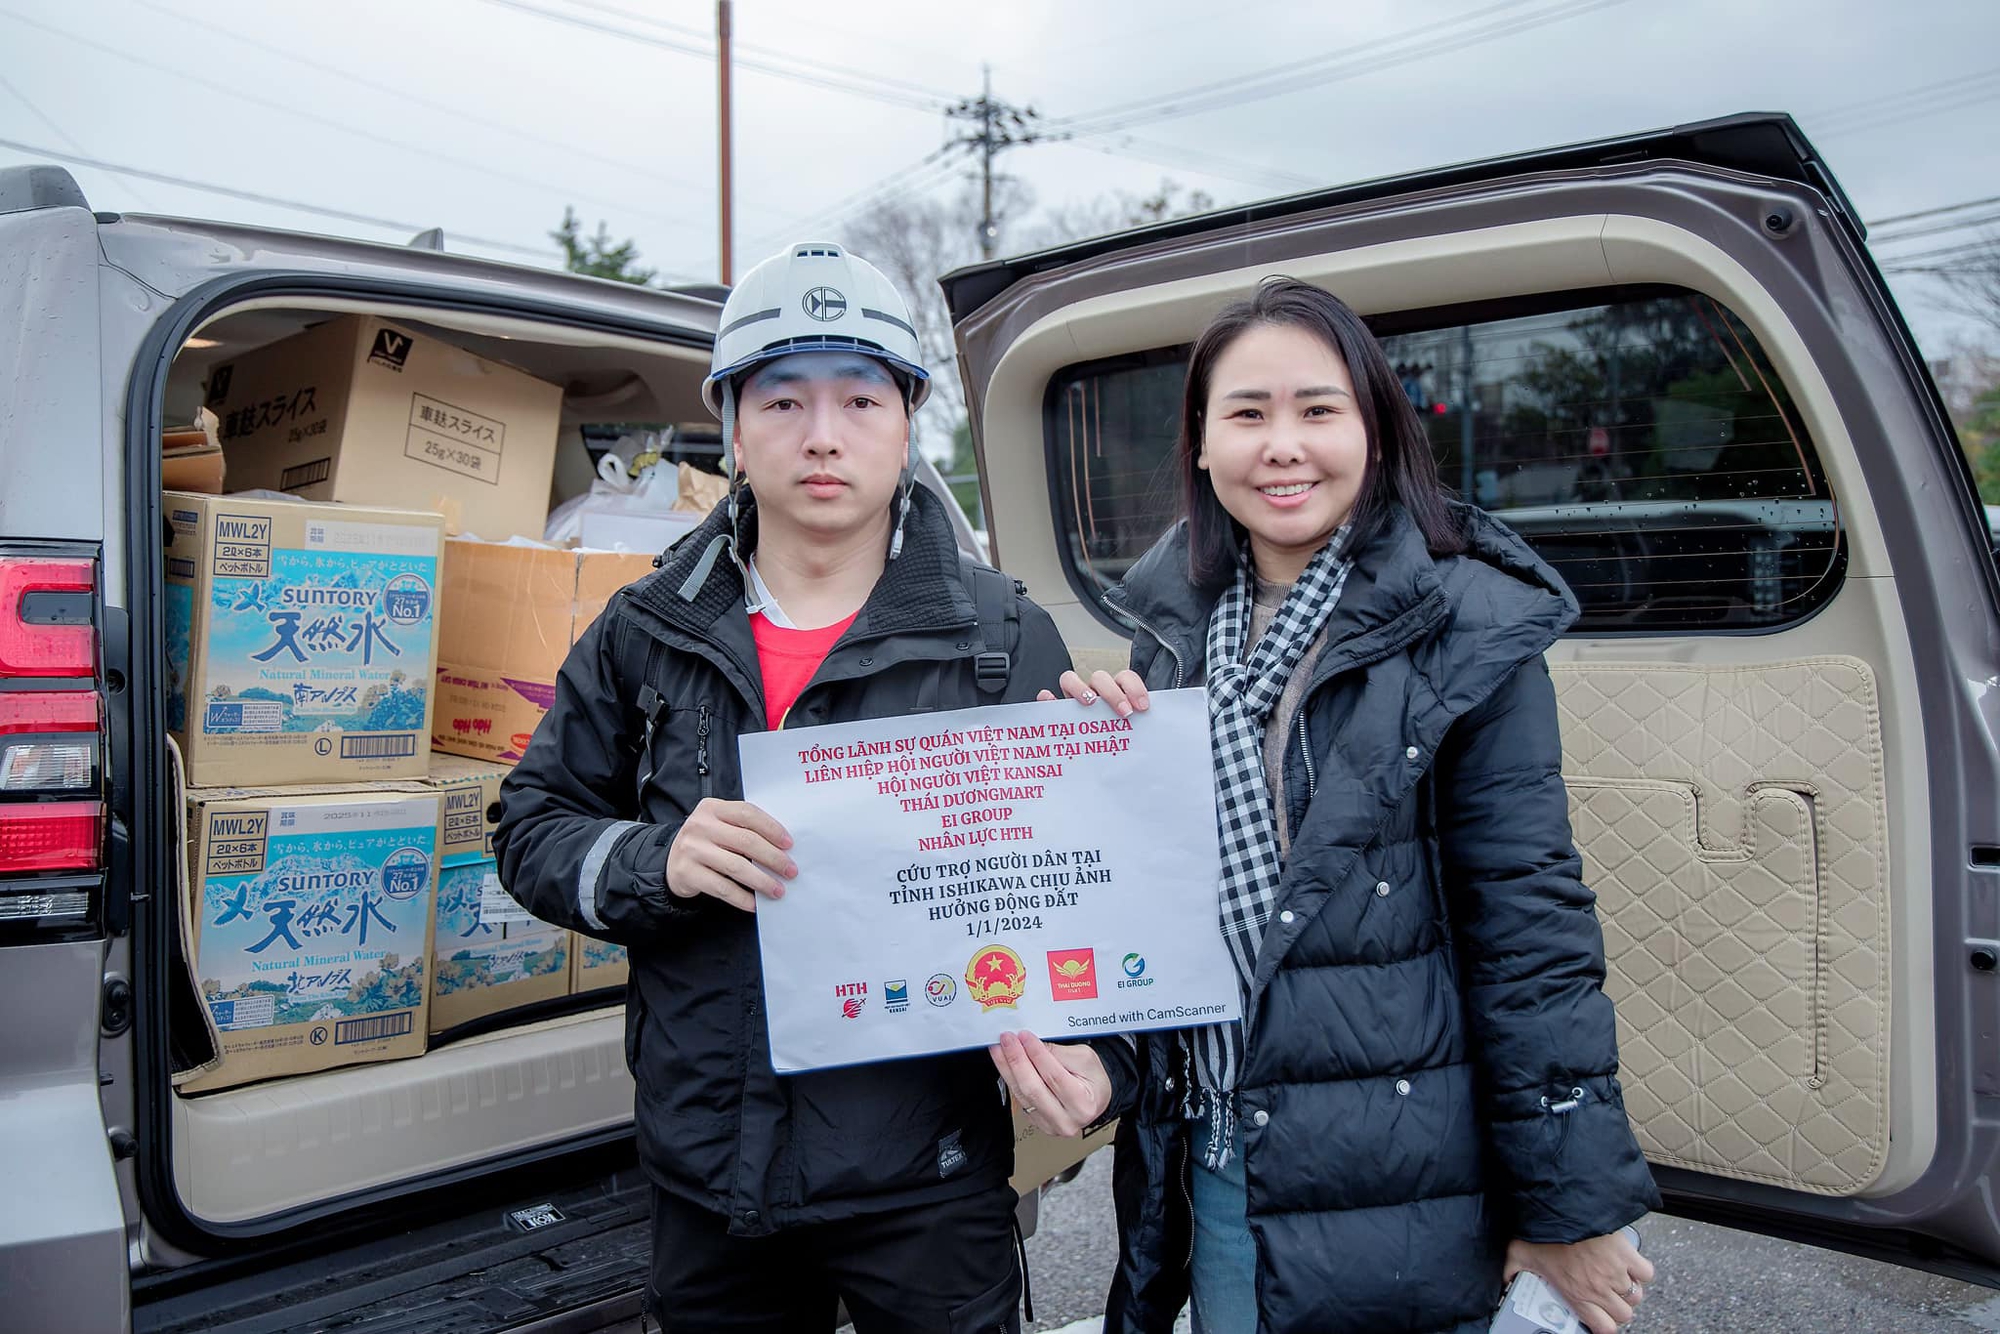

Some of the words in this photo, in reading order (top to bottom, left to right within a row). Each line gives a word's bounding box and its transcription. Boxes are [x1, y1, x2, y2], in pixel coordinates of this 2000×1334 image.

[219, 521, 268, 540] MWL2Y
[219, 562, 263, 574] ペットボトル
[283, 588, 378, 607] SUNTORY
[392, 604, 421, 618] No.1
[251, 610, 401, 666] 天然水
[259, 669, 306, 680] Natural
[309, 669, 356, 680] Mineral
[359, 669, 391, 680] Water
[798, 743, 844, 765] TỔNG
[847, 740, 894, 758] LÃNH
[895, 737, 917, 754] SỰ
[919, 729, 964, 752] QUÁN
[966, 726, 1004, 745] VIỆT
[1006, 725, 1046, 740] NAM
[1048, 723, 1075, 740] TẠI
[1078, 718, 1133, 735] OSAKA
[804, 763, 842, 784] LIÊN
[845, 760, 884, 780] HIỆP
[886, 758, 917, 776] HỘI
[919, 748, 972, 770] NGƯỜI
[972, 745, 1010, 765] VIỆT
[1012, 744, 1051, 760] NAM
[1053, 742, 1081, 759] TẠI
[1084, 735, 1130, 754] NHẬT
[877, 777, 907, 797] HỘI
[909, 769, 962, 791] NGƯỜI
[963, 764, 1001, 785] VIỆT
[1003, 764, 1063, 780] KANSAI
[446, 792, 480, 810] MWL2Y
[900, 793, 941, 812] THÁI
[942, 785, 1045, 807] DƯƠNGMART
[213, 818, 264, 836] MWL2Y
[941, 814, 959, 828] EI
[960, 807, 1013, 825] GROUP
[918, 831, 965, 851] NHÂN
[969, 828, 998, 846] LỰC
[1000, 826, 1033, 841] HTH
[213, 857, 257, 870] ペットボトル
[897, 864, 933, 884] CỨU
[936, 860, 972, 881] TRỢ
[975, 851, 1028, 873] NGƯỜI
[1031, 850, 1068, 868] DÂN
[1072, 850, 1102, 870] TẠI
[278, 870, 374, 892] SUNTORY
[390, 877, 419, 893] No.1
[889, 883, 935, 904] TỈNH
[938, 876, 1028, 902] ISHIKAWA
[1030, 870, 1070, 892] CHỊU
[1074, 866, 1113, 886] ẢNH
[928, 897, 991, 922] HƯỞNG
[995, 891, 1042, 916] ĐỘNG
[1045, 888, 1079, 908] ĐẤT
[244, 891, 397, 953] 天然水
[966, 914, 1043, 938] 1/1/2024
[252, 957, 300, 972] Natural
[304, 953, 351, 966] Mineral
[354, 950, 386, 961] Water
[835, 982, 868, 998] HTH
[1117, 979, 1125, 989] EI
[1127, 977, 1154, 988] GROUP
[1067, 1012, 1117, 1028] Scanned
[1119, 1010, 1145, 1024] with
[1147, 1003, 1227, 1022] CamScanner
[941, 1152, 964, 1168] TULTEX
